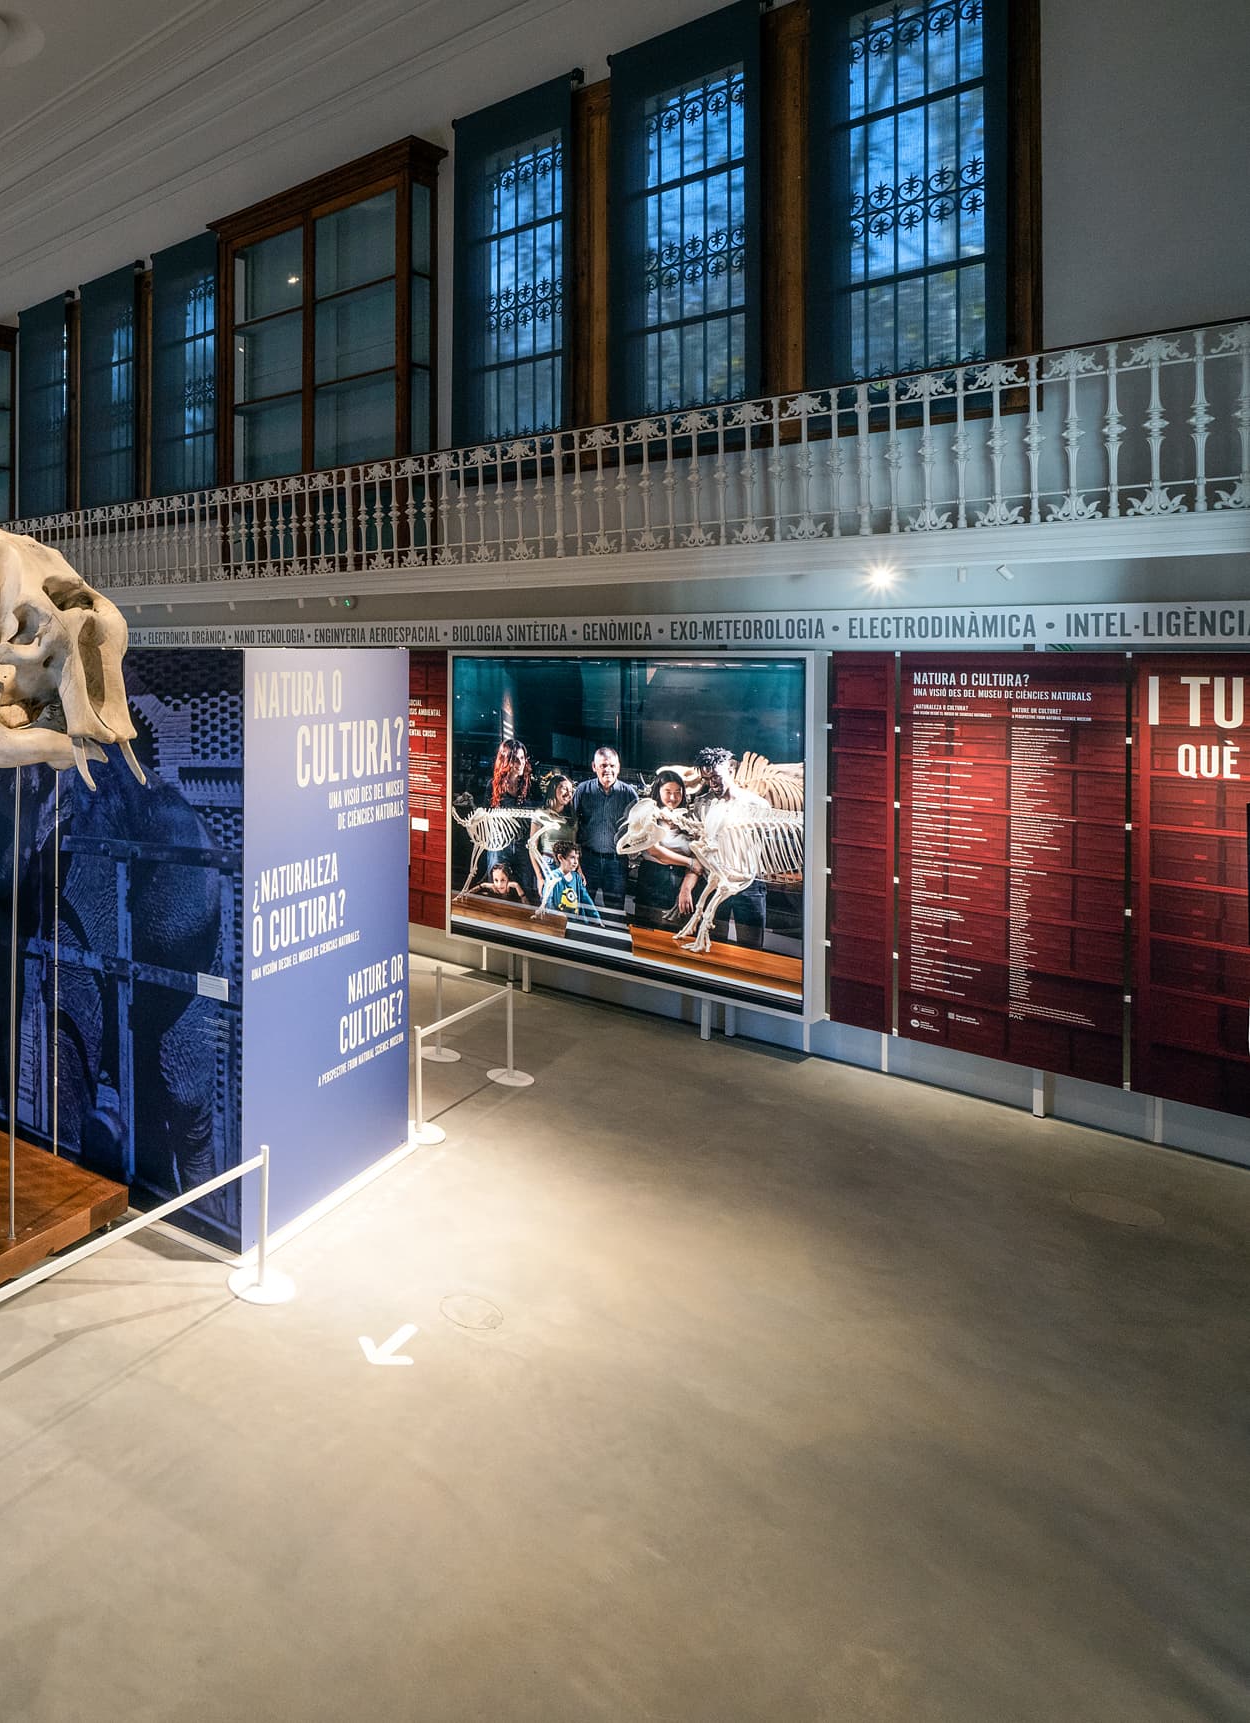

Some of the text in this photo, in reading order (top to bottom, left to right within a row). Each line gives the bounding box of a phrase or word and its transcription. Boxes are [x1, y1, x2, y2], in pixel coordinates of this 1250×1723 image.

[191, 629, 226, 645] ORGÀNICA
[234, 630, 255, 644] NANO
[256, 629, 305, 644] TECNOLOGIA
[314, 627, 366, 643] ENGINYERIA
[369, 625, 441, 643] AEROESPACIAL
[452, 624, 502, 642] BIOLOGIA
[506, 620, 567, 642] SINTÈTICA
[582, 619, 652, 641] GENÒMICA
[670, 618, 825, 641] EXO-METEOROLOGIA
[848, 610, 1037, 639] ELECTRODINÀMICA
[1066, 606, 1250, 637] INTEL·LIGÈNCI
[253, 669, 343, 720] NATURA O
[913, 672, 1030, 688] NATURA O CULTURA?
[913, 686, 1092, 702] UNA VISIÓ DES DEL MUSEU DE CIÈNCIES NATURALS
[1148, 676, 1244, 728] I TU
[296, 716, 404, 788] CULTURA?
[1178, 740, 1240, 779] QUÈ
[328, 779, 404, 810] UNA VISIÓ DES DEL MUSEU
[338, 800, 404, 831] DE CIÈNCIES NATURALS
[252, 852, 339, 914] ¿NATURALEZA
[252, 888, 347, 958] O CULTURA?
[292, 953, 298, 966] EL
[348, 953, 404, 1004] NATURE OR
[339, 989, 404, 1055] CULTURE?
